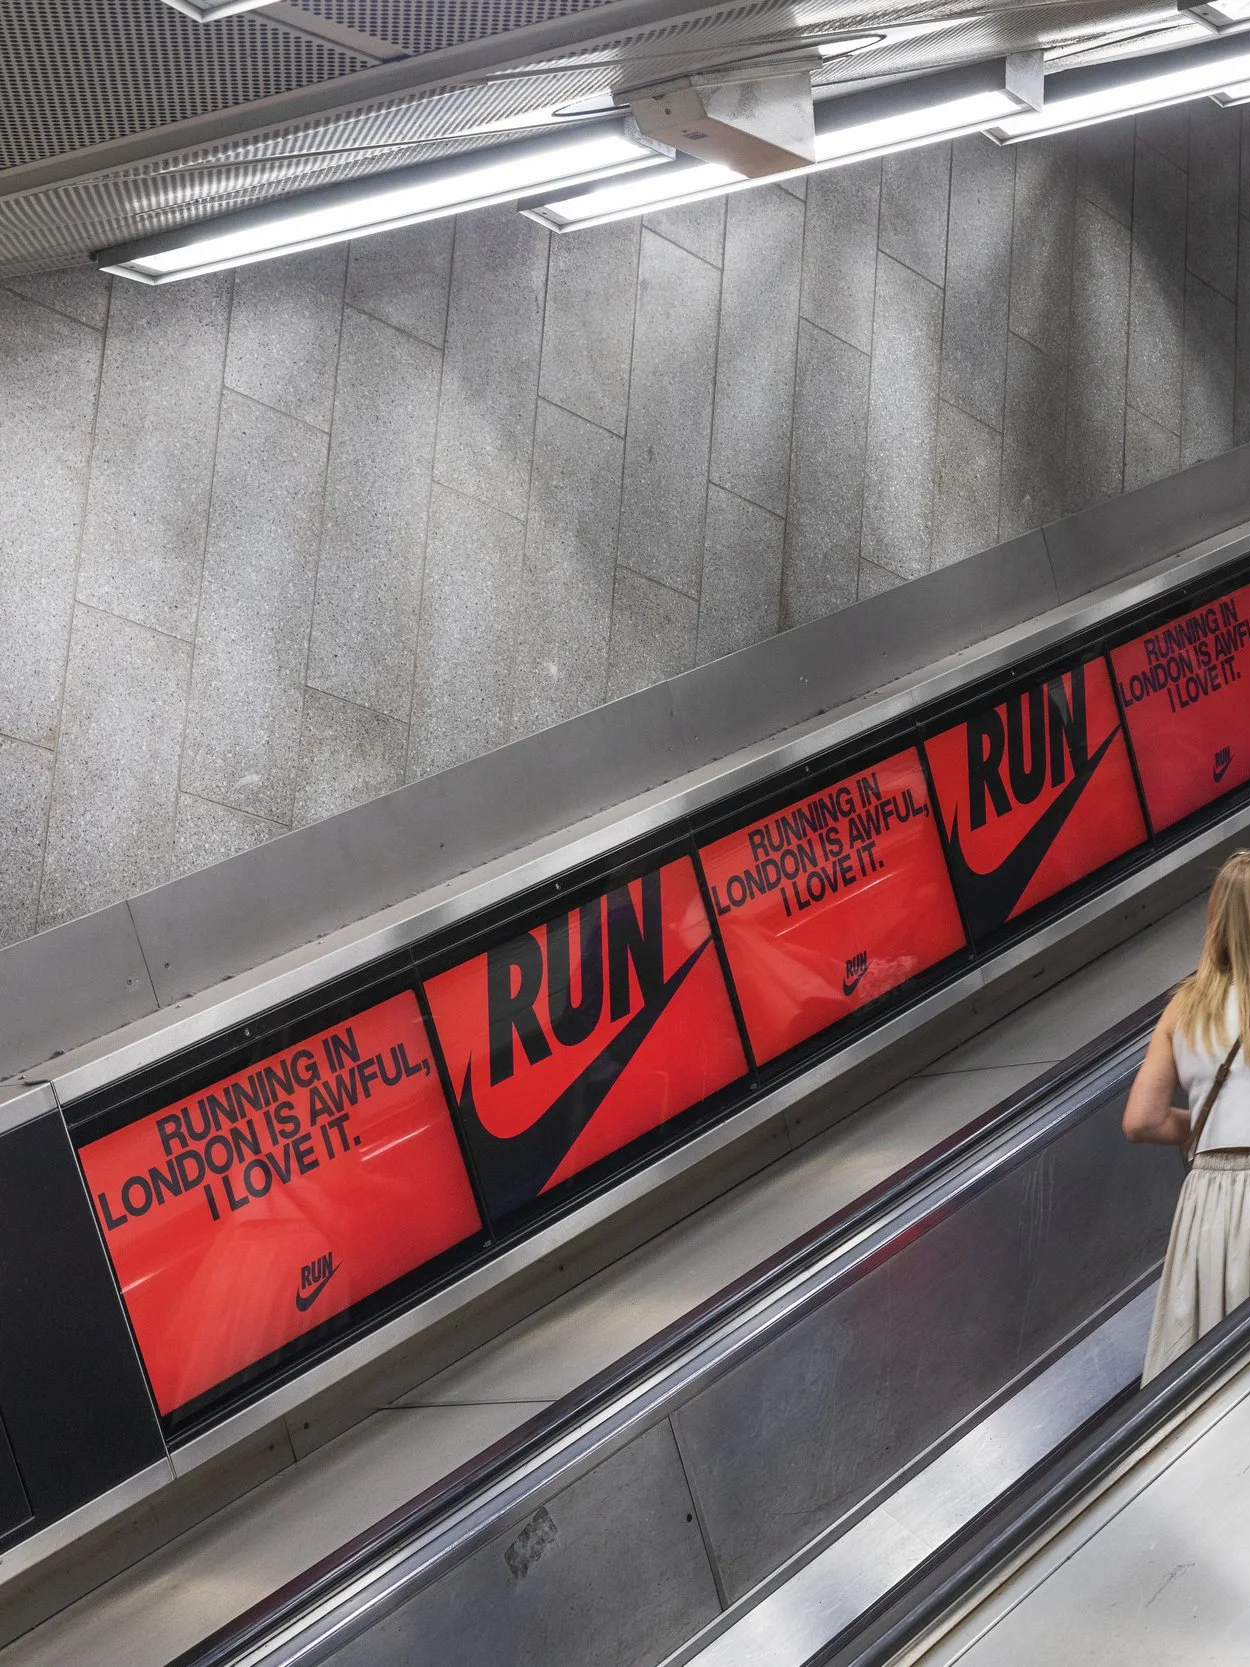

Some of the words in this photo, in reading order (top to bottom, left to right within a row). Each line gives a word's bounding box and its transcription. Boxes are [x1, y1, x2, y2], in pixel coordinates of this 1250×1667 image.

[1144, 608, 1219, 665] RUNNING
[1219, 599, 1238, 627] IN
[1119, 649, 1194, 708] LONDON
[1193, 641, 1211, 670] IS
[1167, 687, 1176, 713] I
[1176, 664, 1221, 708] LOVE
[1220, 655, 1241, 685] IT.
[966, 664, 1089, 832] RUN
[1215, 746, 1231, 767] RUN
[711, 838, 818, 916] LONDON
[818, 827, 844, 861] IS
[849, 789, 929, 849] AWFUL,
[748, 787, 856, 862] RUNNING
[856, 772, 882, 808] IN
[780, 887, 792, 917] I
[792, 854, 856, 911] LOVE
[855, 841, 884, 878] IT.
[485, 866, 664, 1088] RUN
[845, 951, 867, 979] RUN
[156, 1049, 321, 1157] RUNNING
[322, 1027, 360, 1073] IN
[97, 1118, 262, 1231] LONDON
[263, 1101, 300, 1147] IS
[309, 1043, 431, 1127] AWFUL,
[203, 1184, 220, 1222] I
[222, 1132, 320, 1211] LOVE
[320, 1112, 361, 1160] IT.
[301, 1251, 333, 1290] RUN
